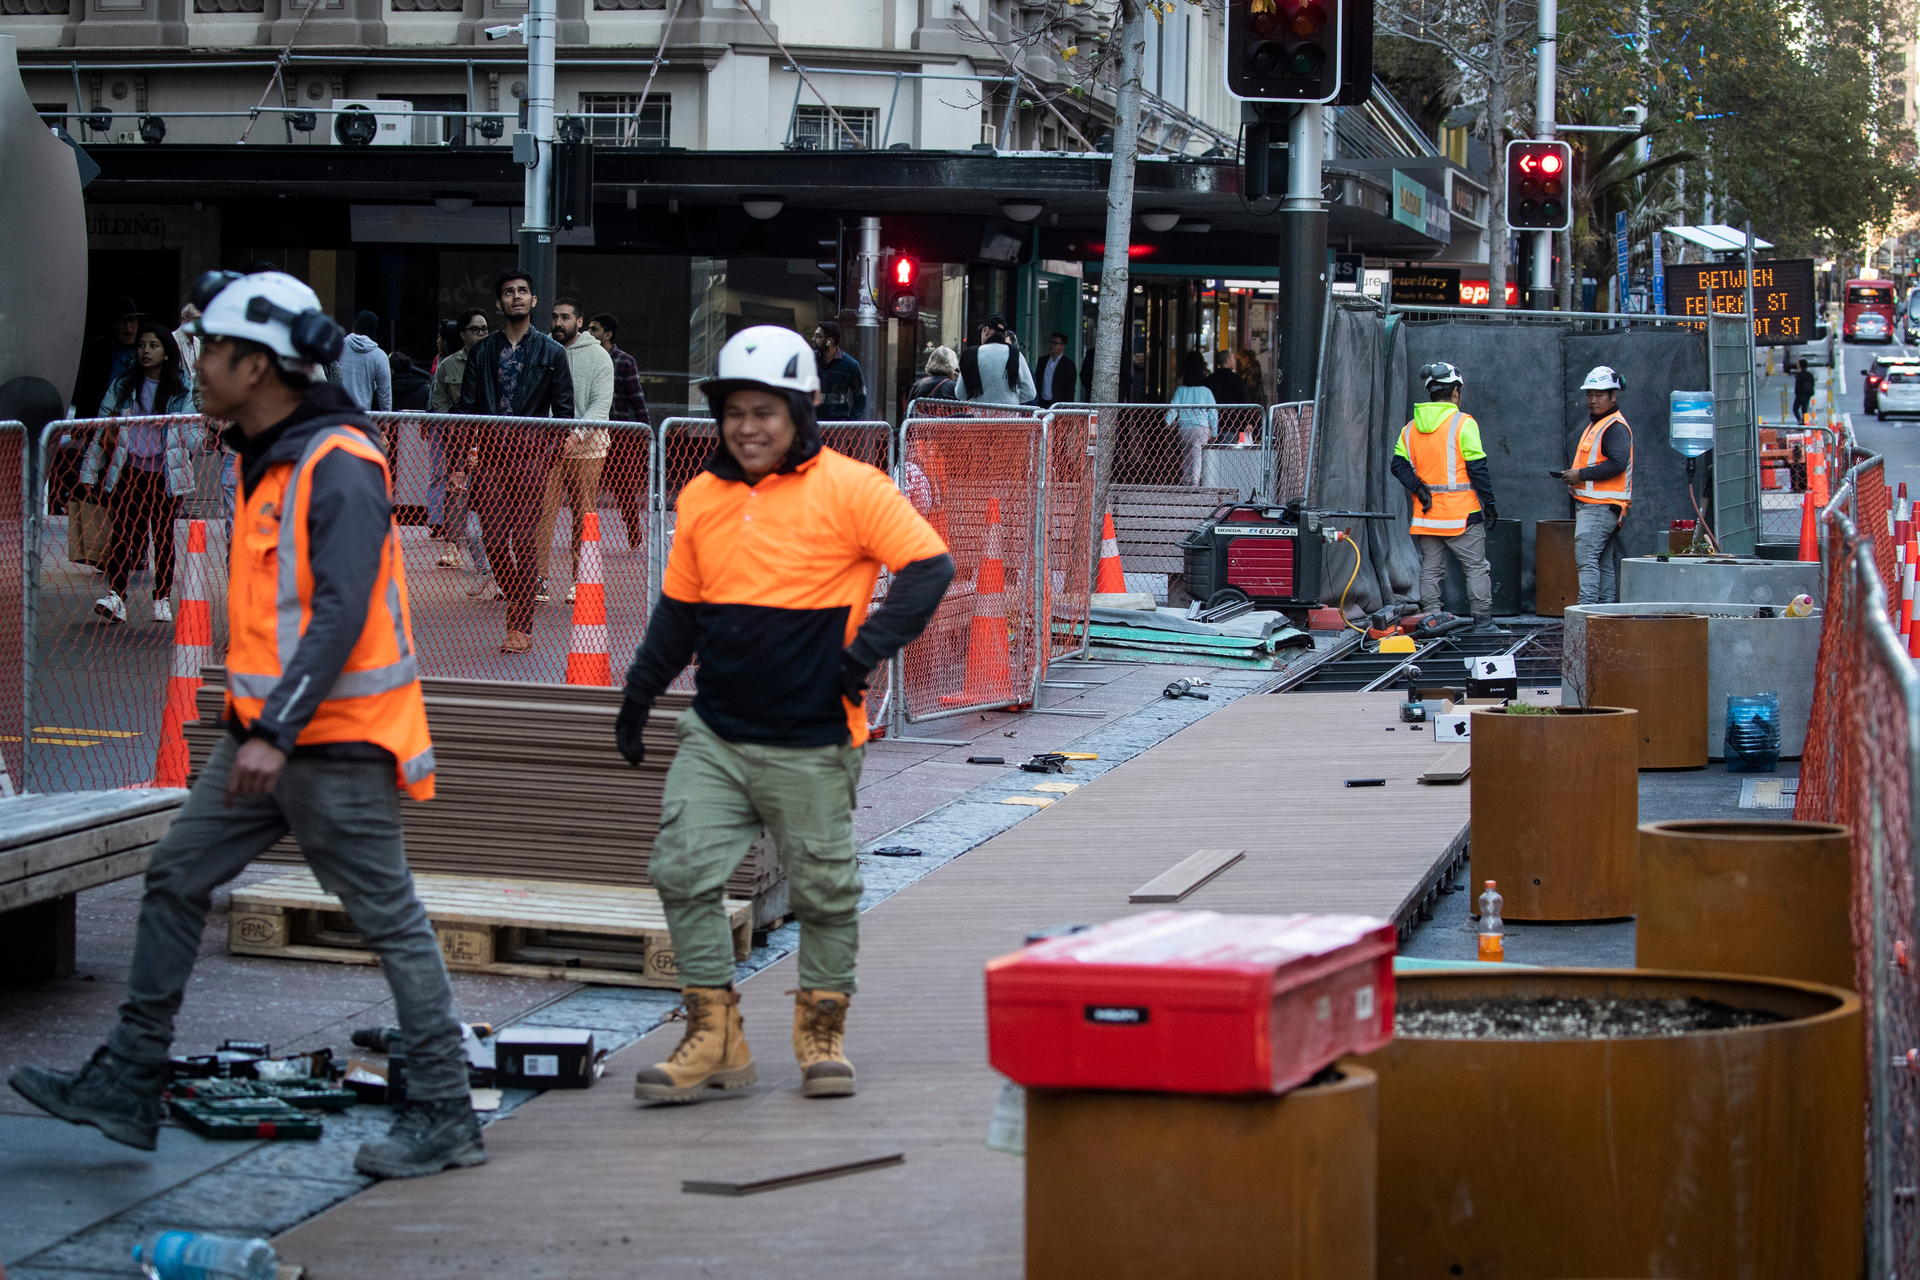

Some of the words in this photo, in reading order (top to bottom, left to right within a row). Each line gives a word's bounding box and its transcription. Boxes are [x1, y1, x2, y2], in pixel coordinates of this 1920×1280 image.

[86, 217, 160, 235] UILDING
[1393, 275, 1448, 289] ewellery
[1768, 293, 1788, 311] ST
[1781, 316, 1800, 335] ST
[241, 922, 269, 938] EPAL
